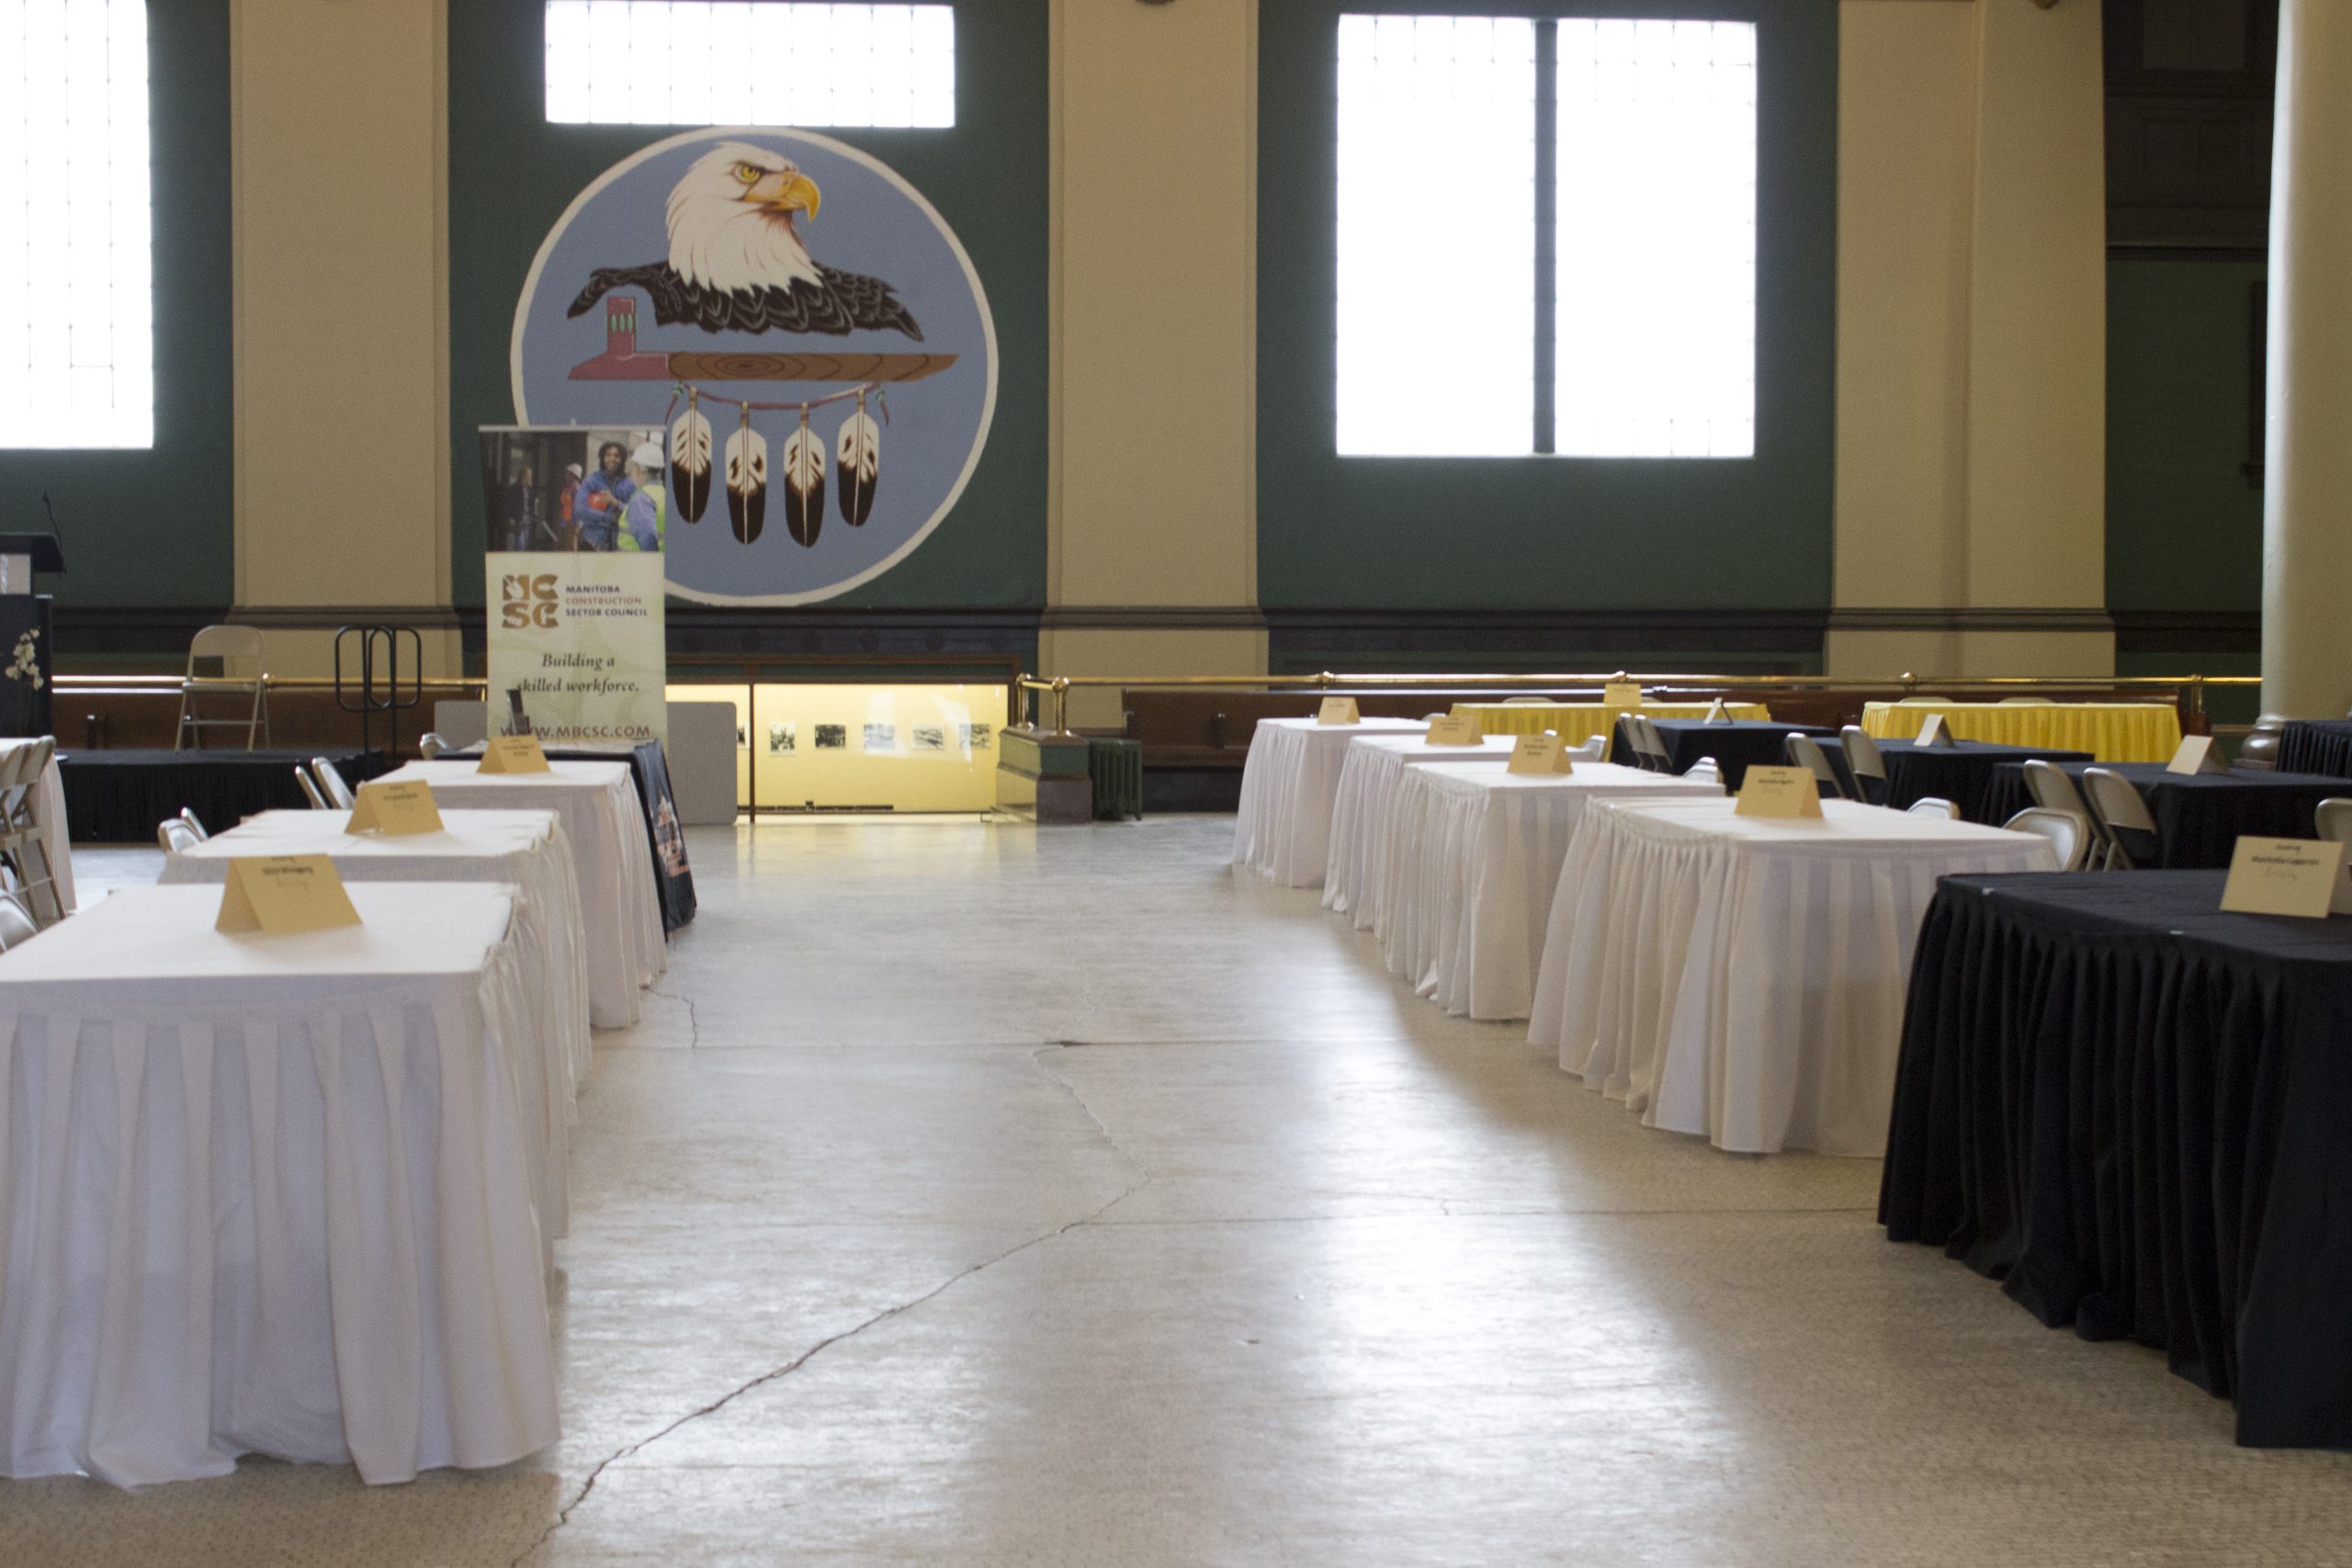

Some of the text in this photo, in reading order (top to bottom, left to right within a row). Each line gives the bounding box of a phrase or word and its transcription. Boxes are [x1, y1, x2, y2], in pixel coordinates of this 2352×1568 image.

[565, 585, 621, 593] MANITOBA
[565, 597, 642, 605] CONSTRUCTION
[565, 608, 649, 616] SECTOR COUNCIL
[542, 653, 615, 671] Building a
[517, 677, 639, 697] skilled workforce.
[500, 726, 650, 738] WW.MBCSC.COM
